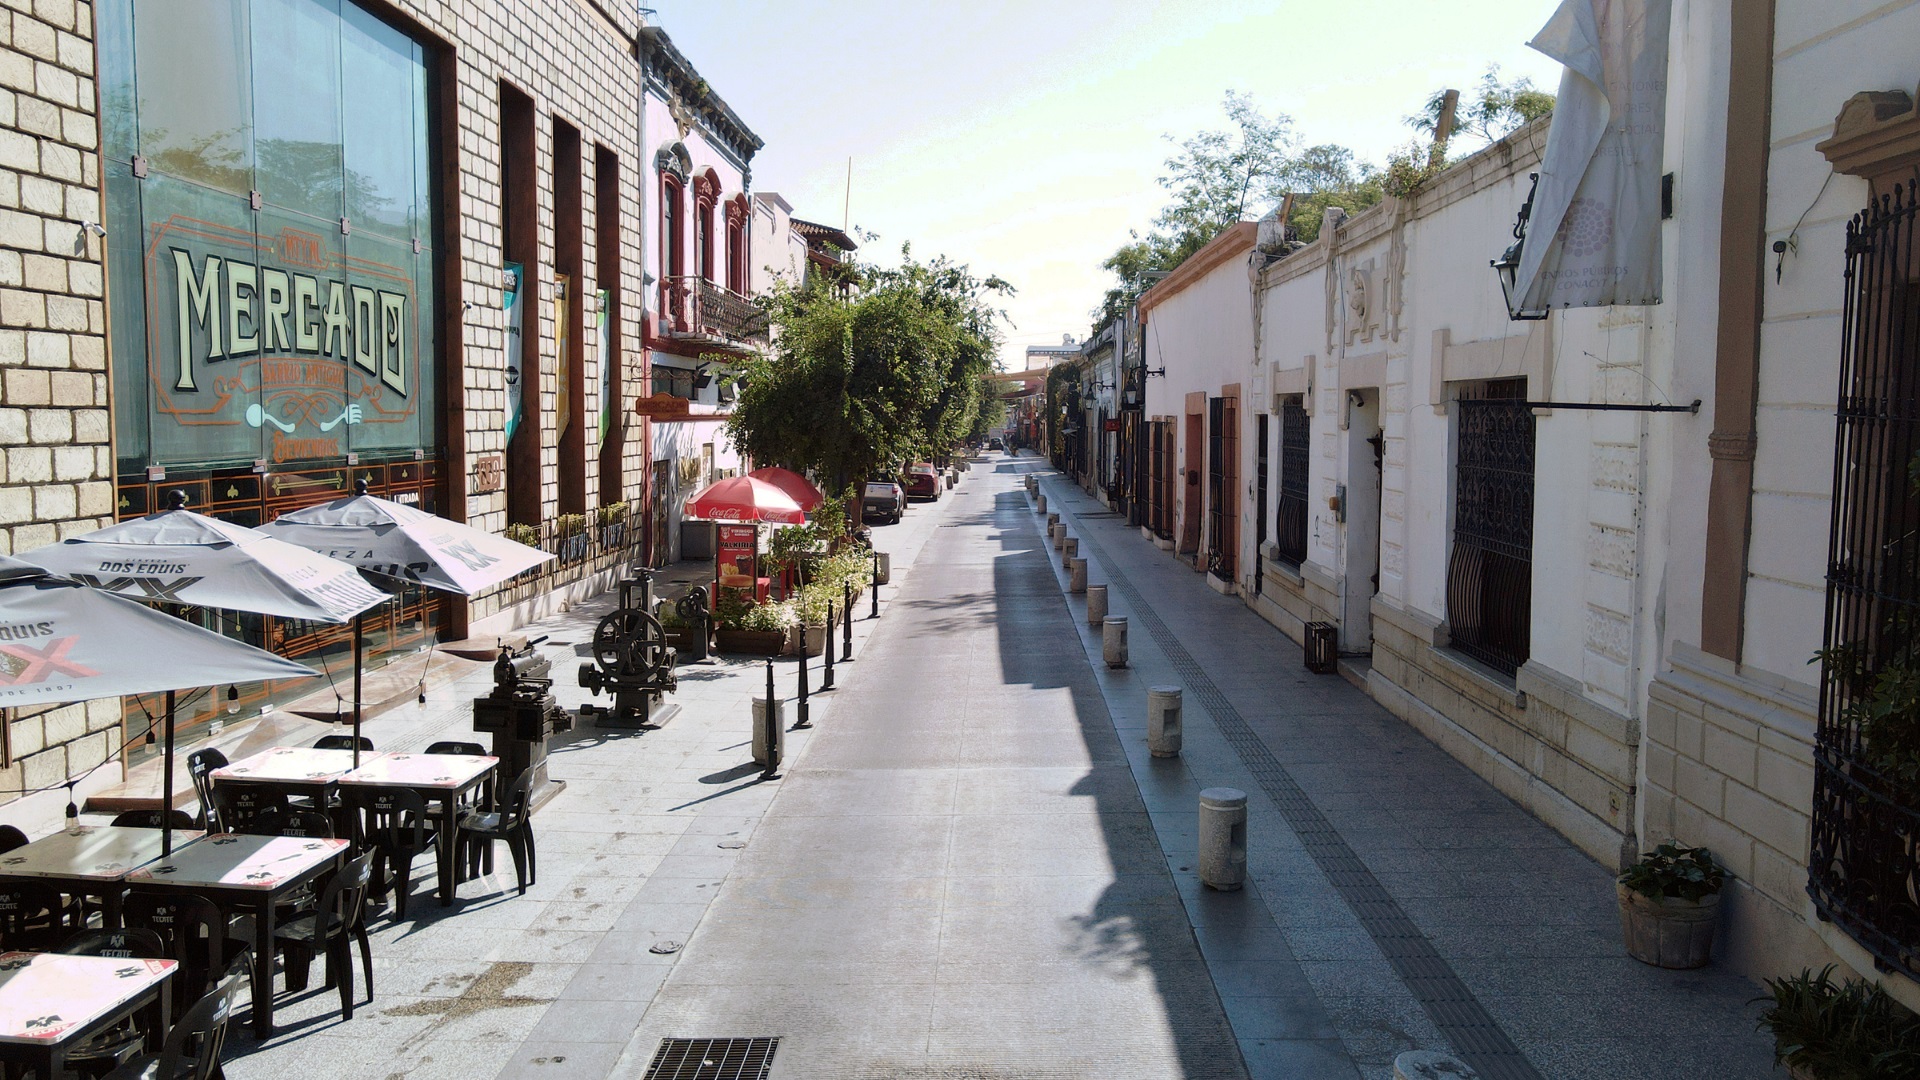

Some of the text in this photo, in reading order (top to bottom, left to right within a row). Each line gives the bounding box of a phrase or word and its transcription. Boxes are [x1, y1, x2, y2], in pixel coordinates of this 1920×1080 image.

[168, 246, 408, 399] MERCADO
[98, 561, 187, 574] DOS EQUIS
[282, 828, 306, 836] TECATE
[152, 915, 174, 923] TECATE
[100, 950, 132, 958] TECATE
